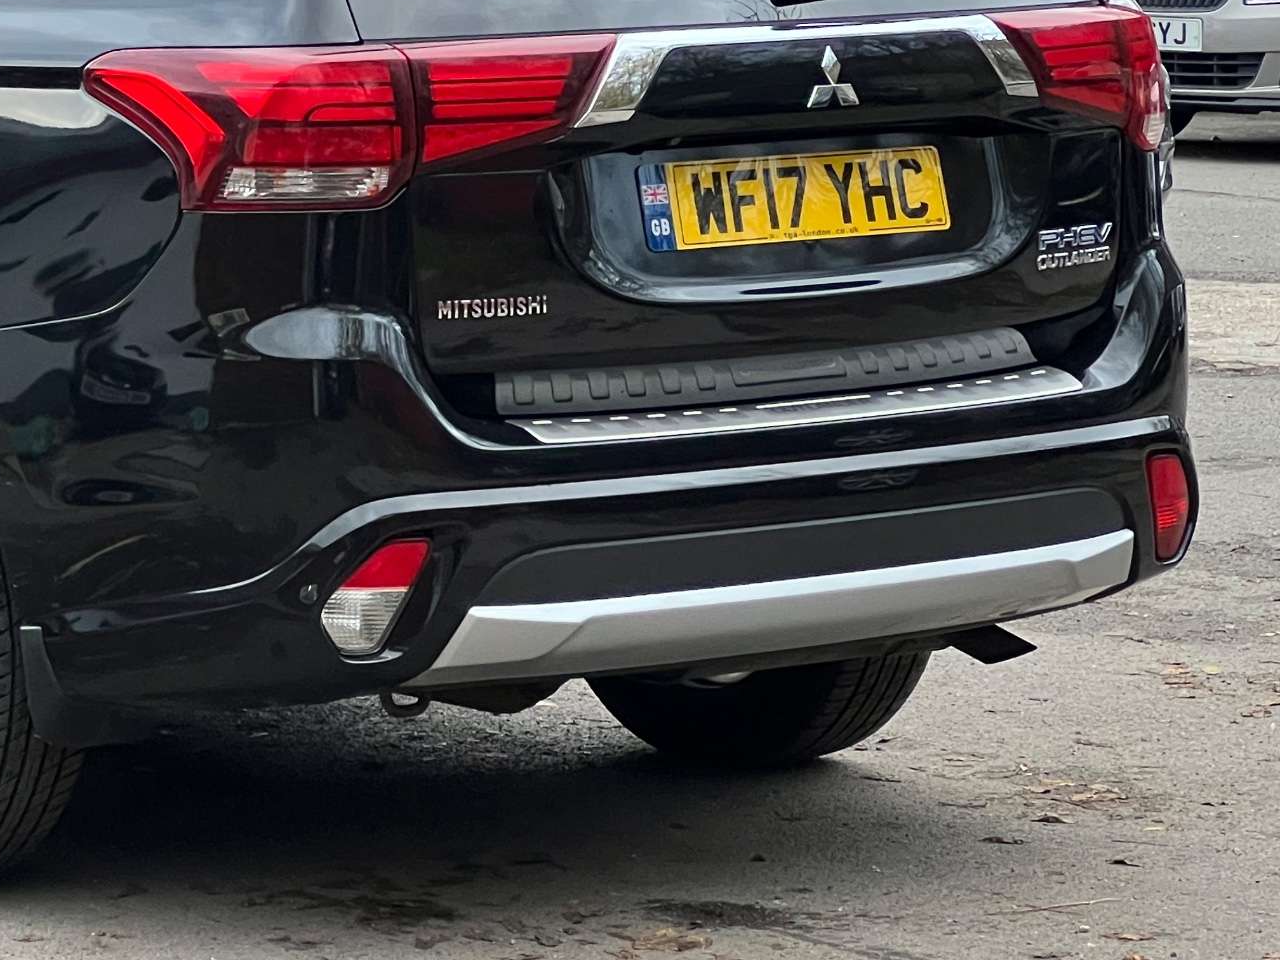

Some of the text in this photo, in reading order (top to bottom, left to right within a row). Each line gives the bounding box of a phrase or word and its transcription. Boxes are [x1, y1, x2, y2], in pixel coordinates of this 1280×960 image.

[1153, 21, 1187, 45] YJ
[690, 158, 930, 235] WF17 YHC
[651, 218, 671, 237] GB
[1038, 222, 1113, 251] PHEV
[1036, 245, 1111, 271] OUTLANDER
[437, 294, 548, 320] MITSUBISHI
